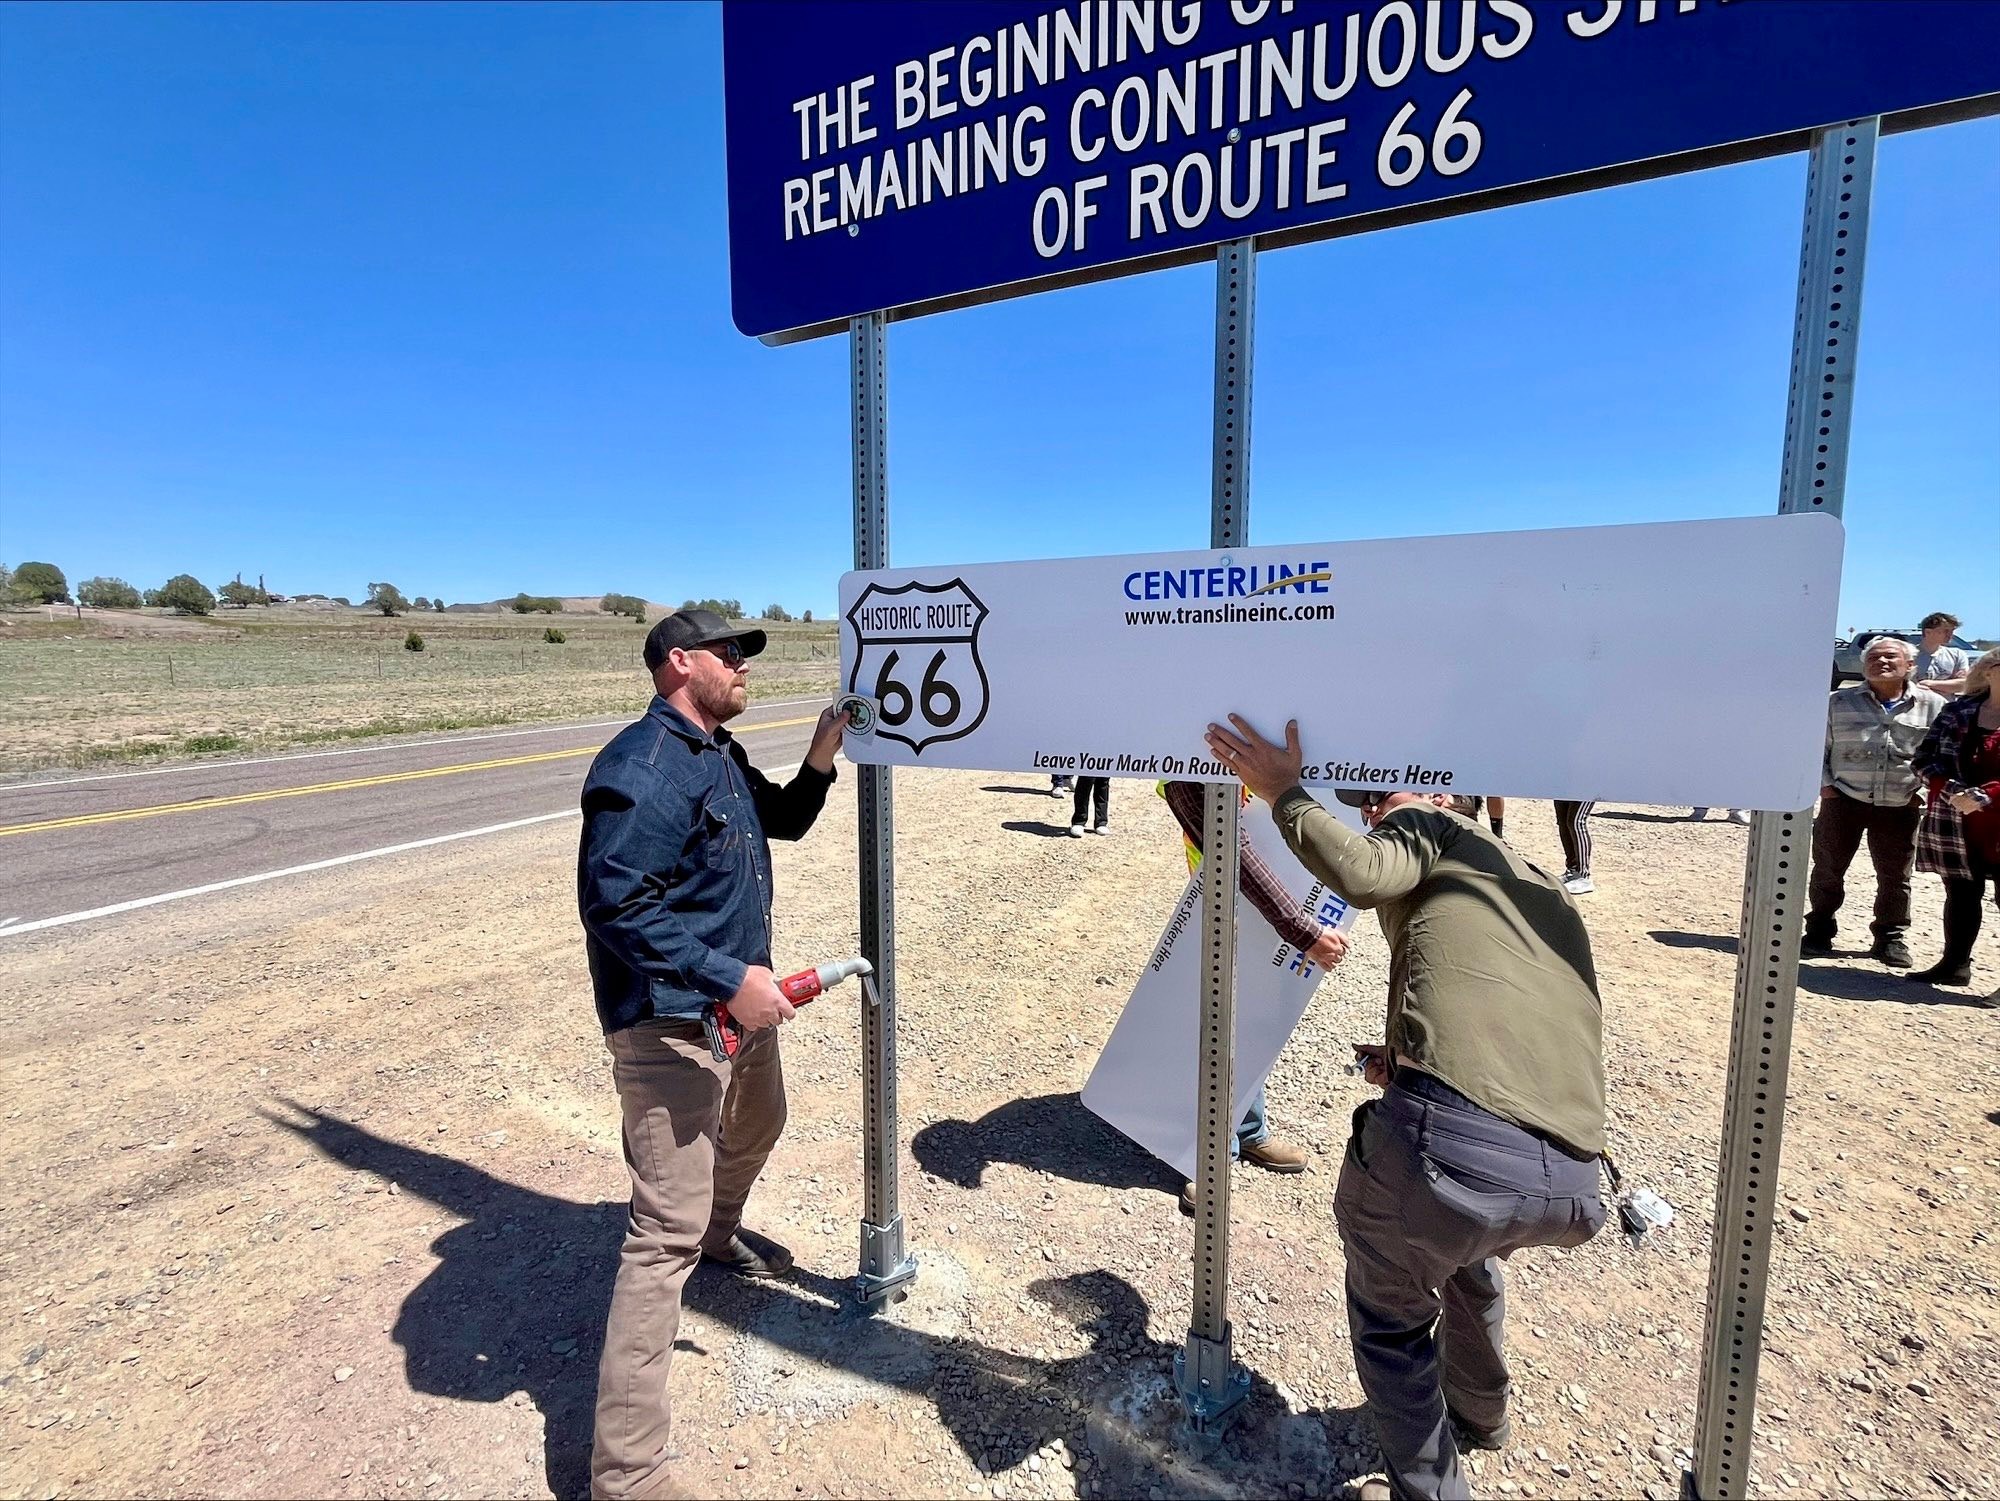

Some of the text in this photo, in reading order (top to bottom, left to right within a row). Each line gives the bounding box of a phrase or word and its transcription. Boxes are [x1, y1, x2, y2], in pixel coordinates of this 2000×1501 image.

[784, 0, 1533, 241] REMAINING CONTINUOUS
[793, 0, 1201, 161] THE BEGINNING
[1032, 89, 1482, 258] OF ROUTE 66
[861, 603, 973, 631] HISTORIC ROUTE
[1123, 562, 1331, 601] CENTERLINE
[1125, 602, 1335, 625] www.translineinc.com
[874, 648, 962, 728] 66
[1033, 751, 1075, 769] Leave
[1078, 752, 1114, 771] Your
[1116, 754, 1159, 773] Mark
[1162, 755, 1184, 774] On
[1322, 761, 1400, 784] Stickers
[1403, 764, 1454, 786] Here
[1151, 879, 1204, 972] Place Stickers Here
